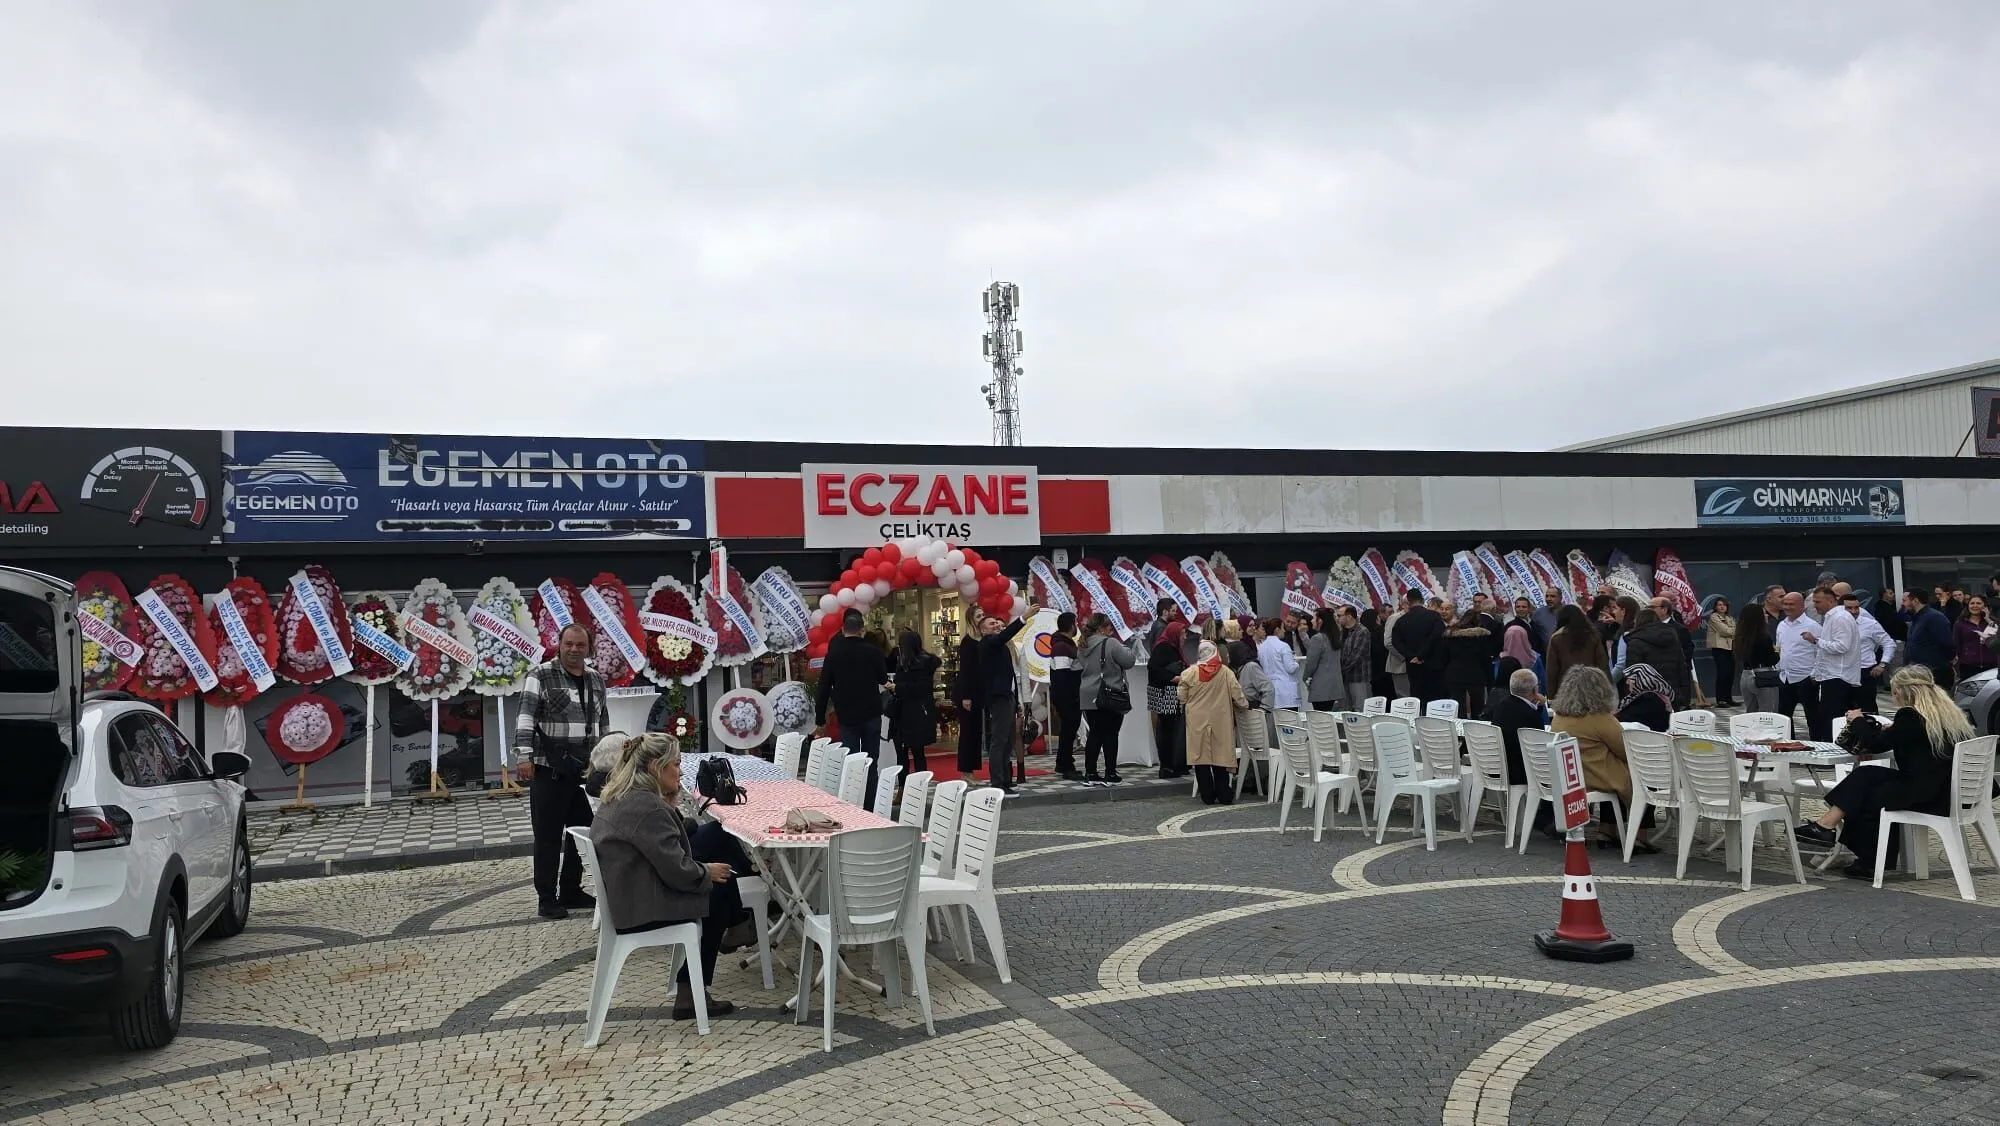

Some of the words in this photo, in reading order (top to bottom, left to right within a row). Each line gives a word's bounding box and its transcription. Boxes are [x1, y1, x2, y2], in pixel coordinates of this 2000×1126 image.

[378, 449, 583, 492] EGEMEN
[596, 453, 688, 498] OTO
[236, 496, 315, 510] EGEMEN
[320, 496, 359, 513] OTO
[443, 501, 471, 514] veya
[473, 499, 524, 512] Hasarsız
[526, 499, 549, 512] Tüm
[552, 499, 594, 514] Araçlar
[596, 500, 628, 512] Alınır
[816, 472, 1029, 517] ECZANE
[1753, 483, 1864, 507] GÜNMARNAK
[0, 523, 49, 535] detailing
[879, 519, 972, 543] ÇELİKTAŞ
[1458, 560, 1475, 586] NERGİS
[1520, 572, 1536, 589] SUAT
[295, 579, 315, 602] HALİL
[1127, 578, 1149, 601] ECZANE
[1144, 567, 1174, 591] BİLİM
[1172, 588, 1194, 617] İLAÇ
[1286, 591, 1308, 609] SAVAŞ
[303, 599, 327, 628] ÇOBAN
[724, 599, 740, 616] YEDİ
[733, 611, 759, 645] KARDEŞLER
[225, 621, 243, 650] BEYZA
[320, 626, 329, 636] ve
[470, 611, 504, 635] KARAMAN
[500, 628, 539, 658] ECZANESİ
[650, 617, 676, 629] MUSTAFA
[698, 632, 708, 642] VE
[154, 608, 183, 641] KADRİYE
[176, 636, 202, 665] DOĞAN
[191, 662, 210, 681] ŞEN
[234, 619, 248, 640] ALTAY
[245, 640, 270, 675] ECZANESİ
[323, 633, 345, 662] AİLESİ
[373, 633, 412, 662] ECZANESİ
[432, 634, 475, 666] ECZANESİ
[1565, 752, 1577, 782] E
[1567, 798, 1586, 815] ECZANE
